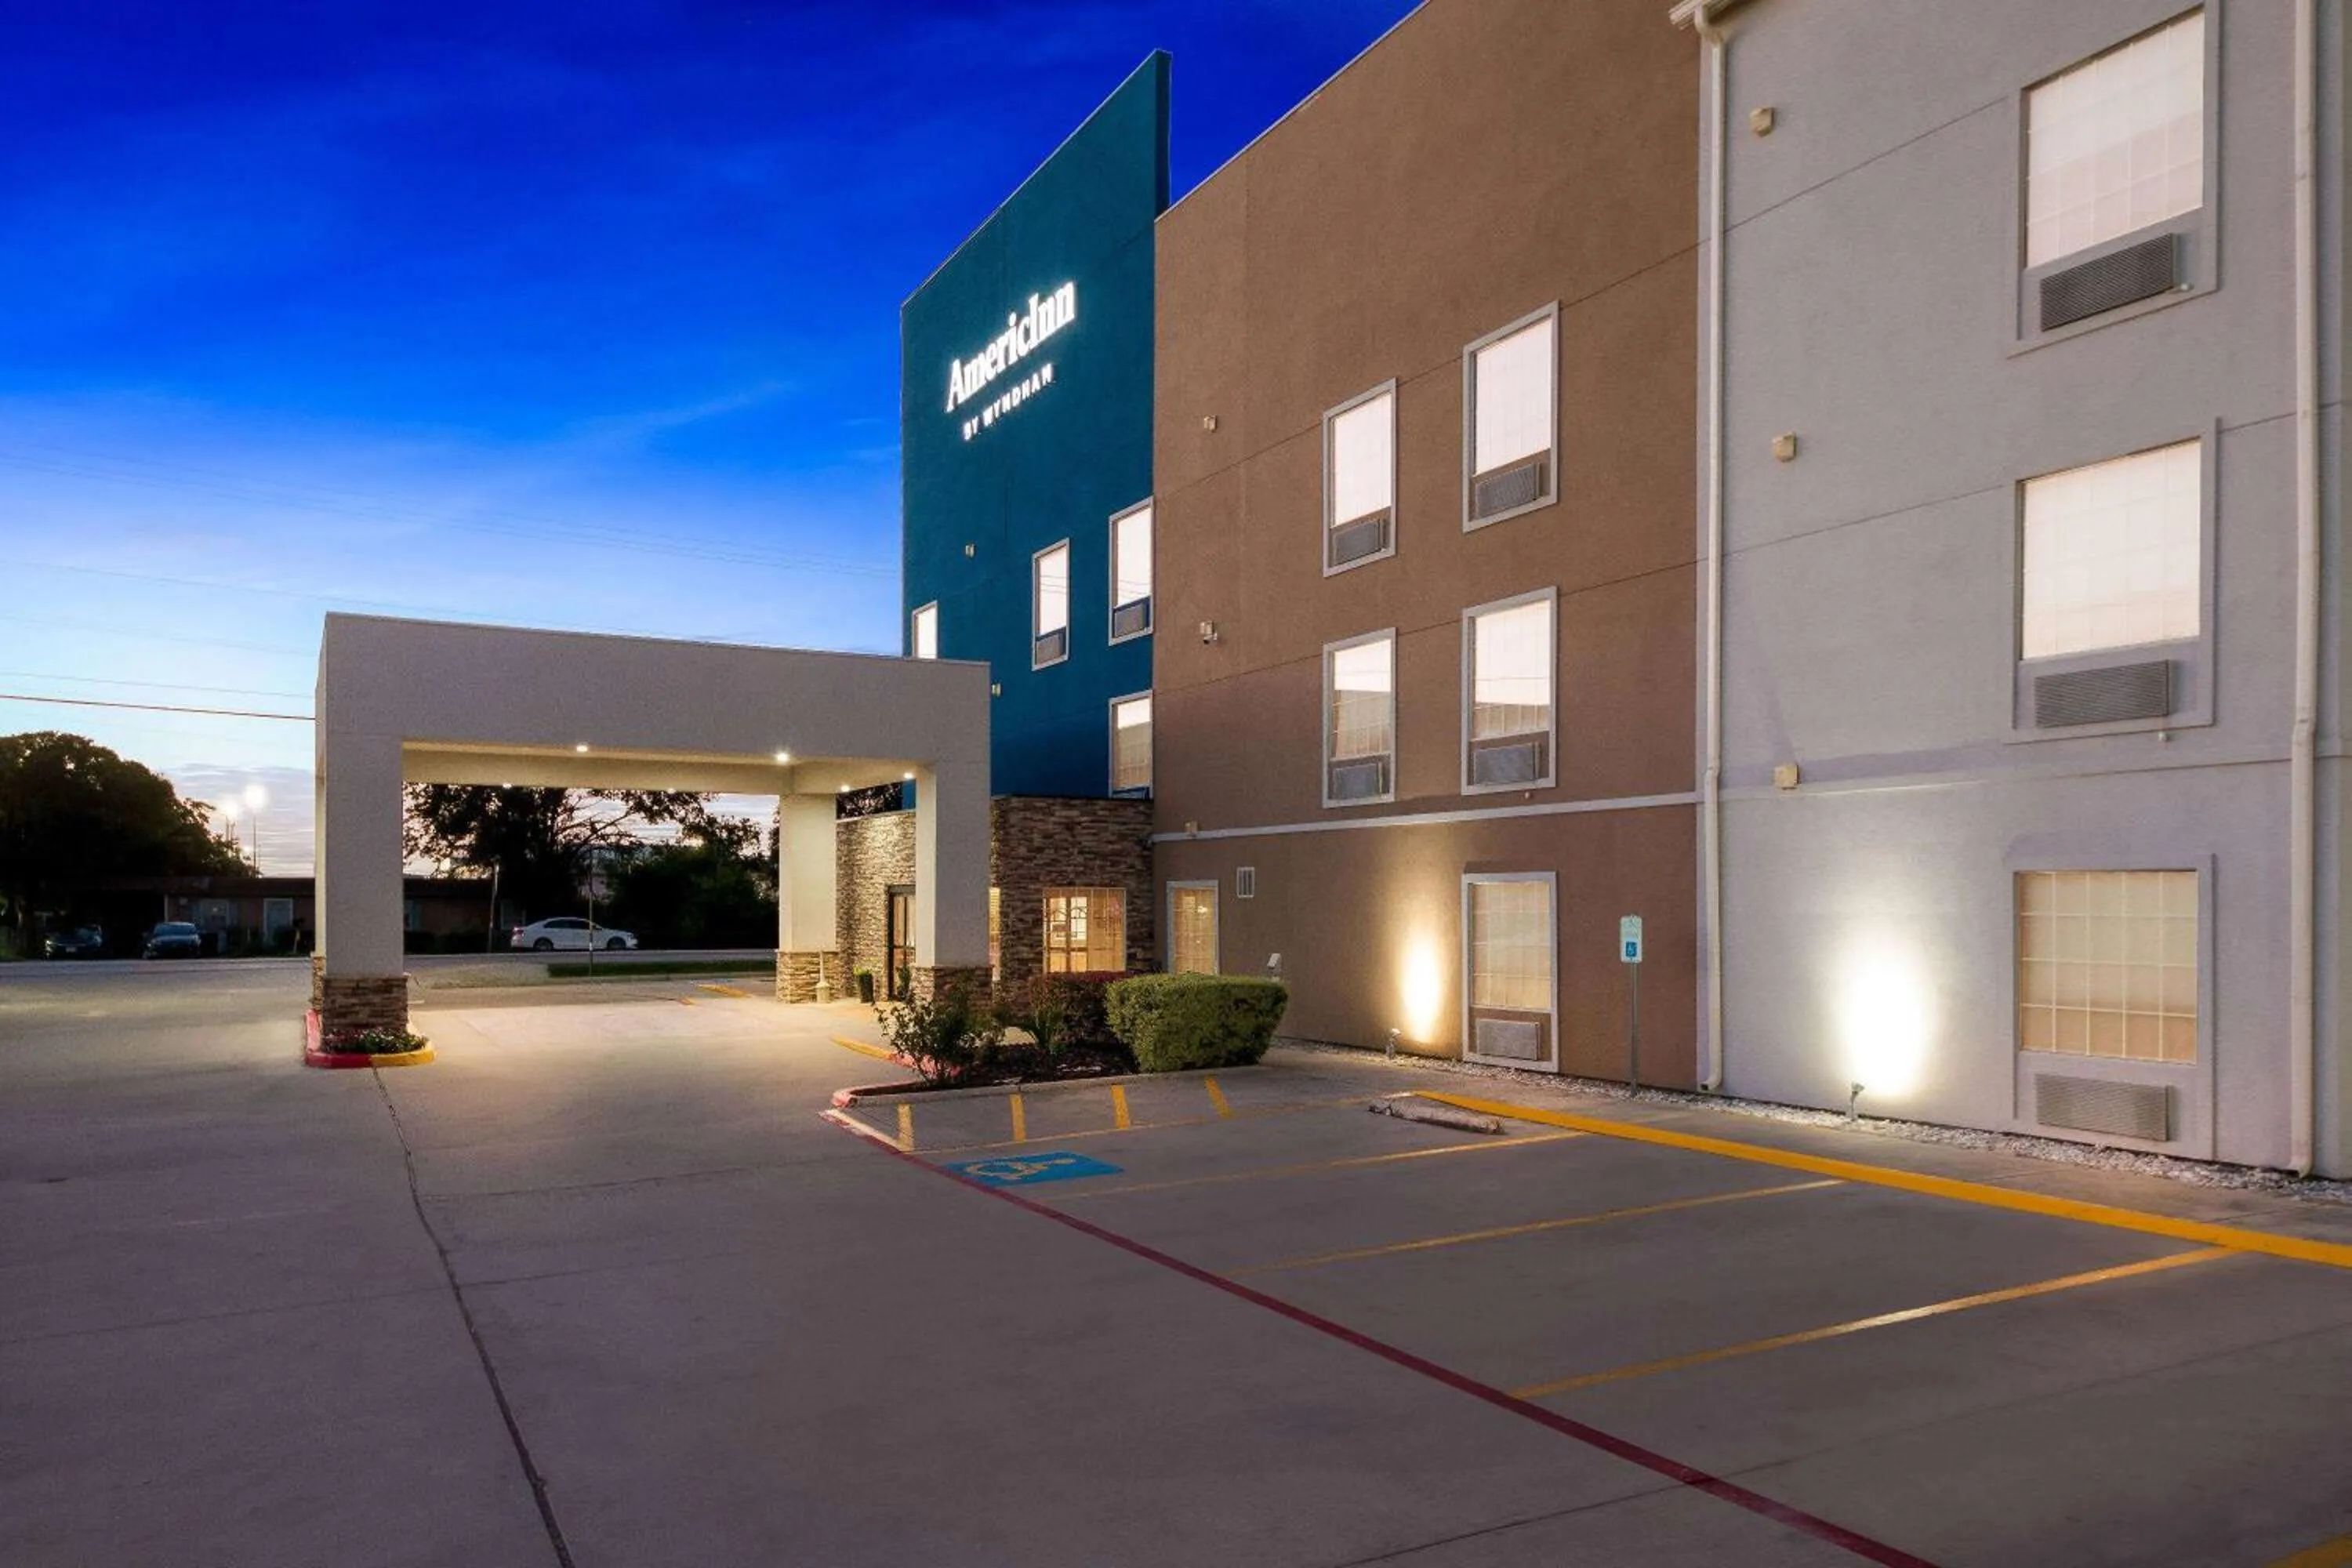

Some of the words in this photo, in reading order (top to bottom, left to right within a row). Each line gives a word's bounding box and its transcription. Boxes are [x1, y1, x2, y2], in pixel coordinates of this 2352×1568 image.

[946, 281, 1076, 412] AmericInn
[963, 416, 979, 441] BY
[982, 363, 1053, 426] WYNDHAM
